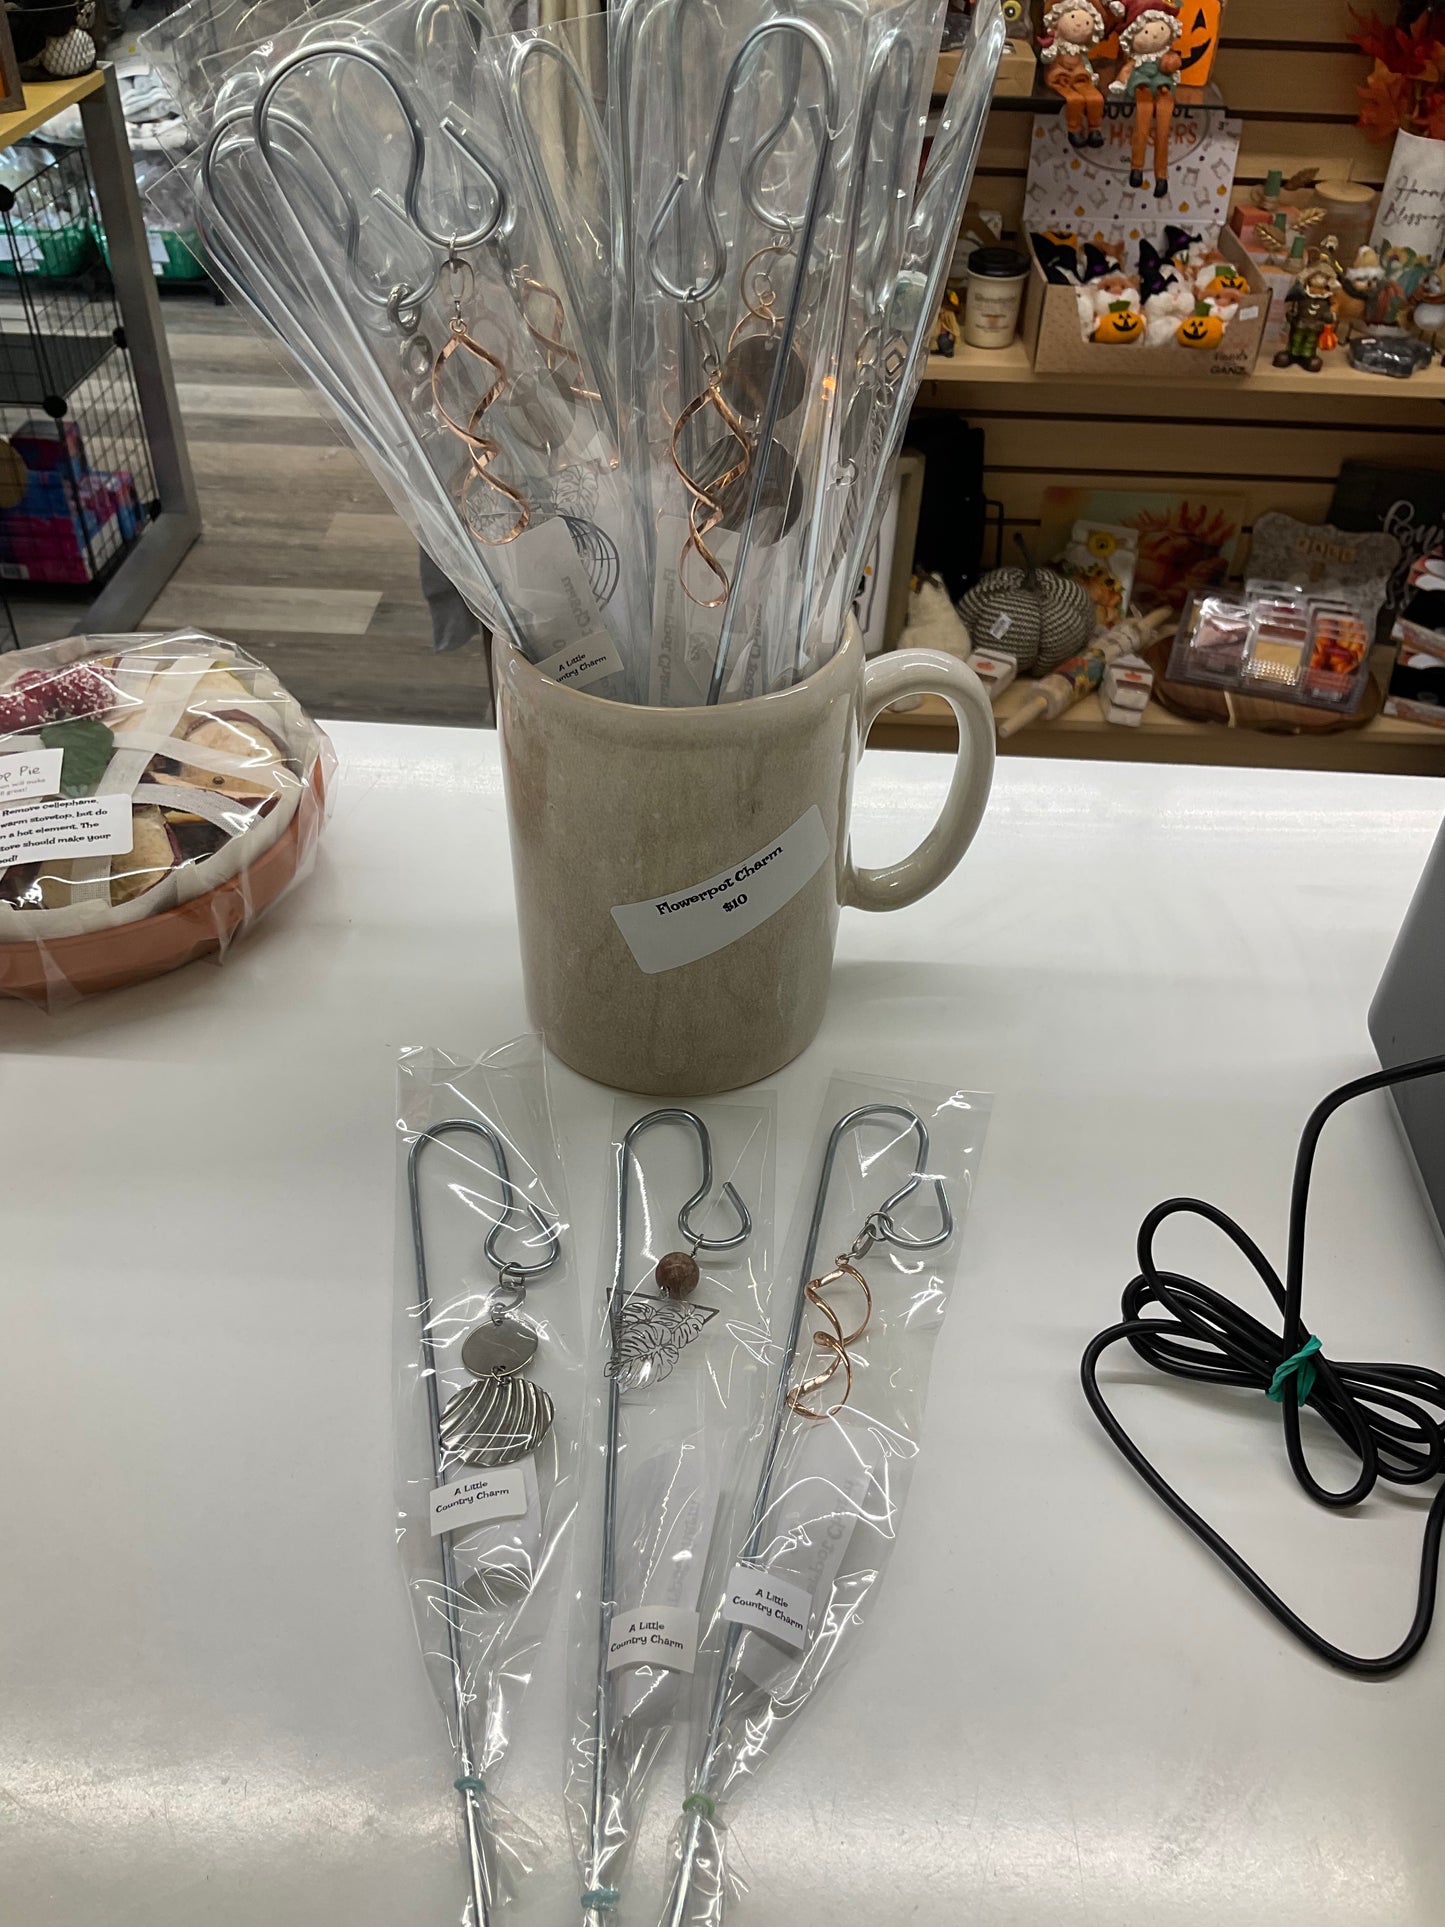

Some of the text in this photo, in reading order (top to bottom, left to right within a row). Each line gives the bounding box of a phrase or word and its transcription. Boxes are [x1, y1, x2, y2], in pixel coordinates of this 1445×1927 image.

[556, 655, 607, 683] untry Charm
[558, 653, 586, 672] A Little
[20, 766, 40, 776] Pie
[2, 806, 40, 816] Remove
[0, 819, 28, 828] warm
[17, 829, 33, 837] hot
[23, 837, 56, 847] should
[58, 835, 85, 843] make
[87, 834, 111, 842] your
[656, 846, 783, 915] Flowerpot Charm
[722, 893, 748, 913] $10
[454, 1481, 488, 1496] A Little
[435, 1489, 509, 1513] Country Charm
[755, 1588, 789, 1607] A Little
[732, 1595, 803, 1630] Country Charm
[628, 1621, 665, 1632] A Little
[610, 1634, 683, 1652] Country Charm
